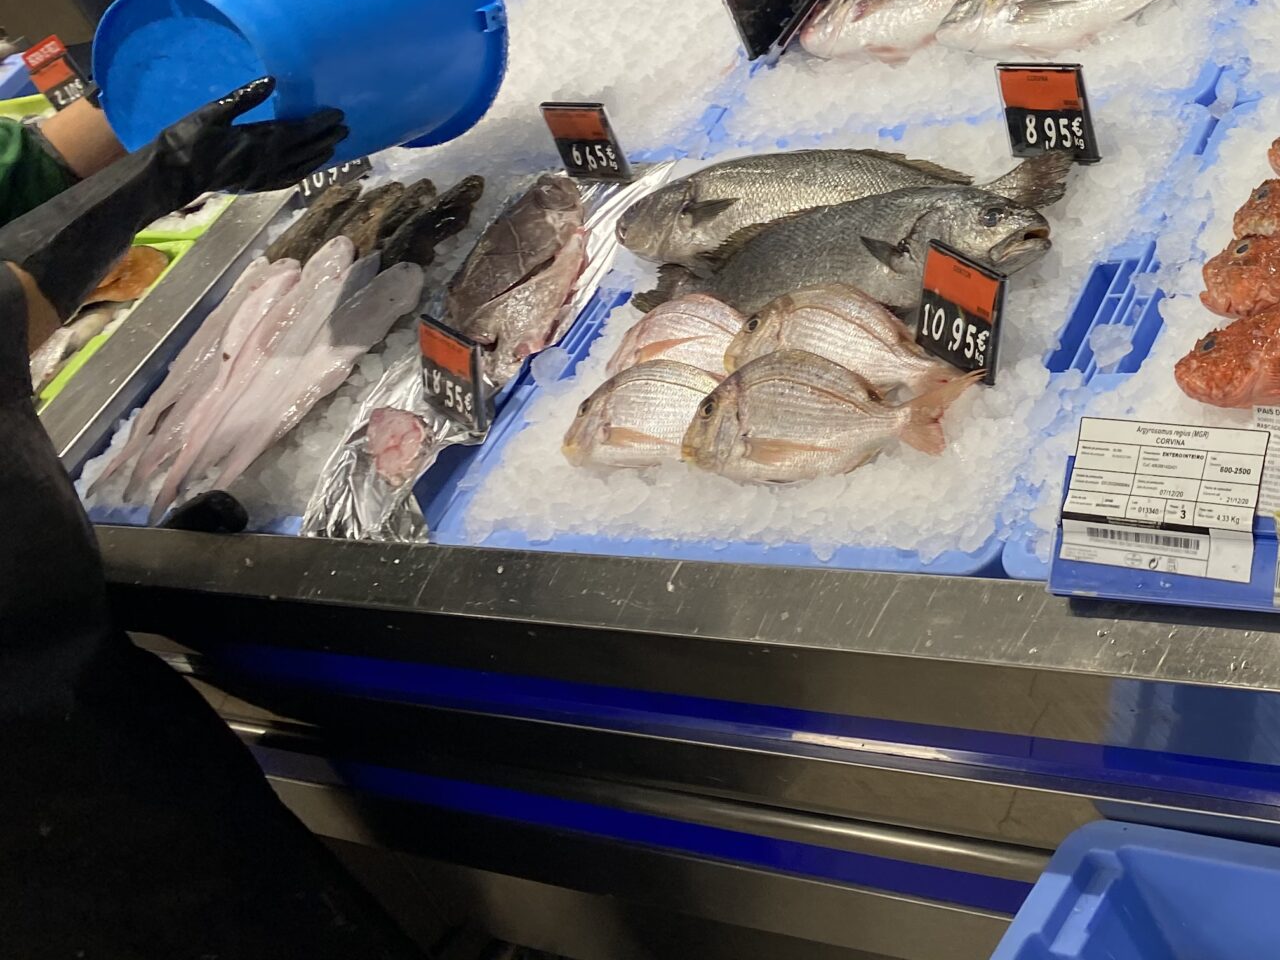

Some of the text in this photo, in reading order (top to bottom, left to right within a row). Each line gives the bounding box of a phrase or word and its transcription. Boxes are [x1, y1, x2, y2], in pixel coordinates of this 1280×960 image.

[1026, 114, 1072, 150] 8,95
[572, 144, 607, 172] 6,65
[922, 303, 977, 359] 10,95
[1136, 426, 1173, 436] Argyrosomus
[1174, 430, 1191, 438] regius
[1156, 437, 1185, 446] CORVINA
[1159, 489, 1184, 498] 07/12/20
[1226, 496, 1249, 505] 21/12/20
[1180, 510, 1186, 520] 3
